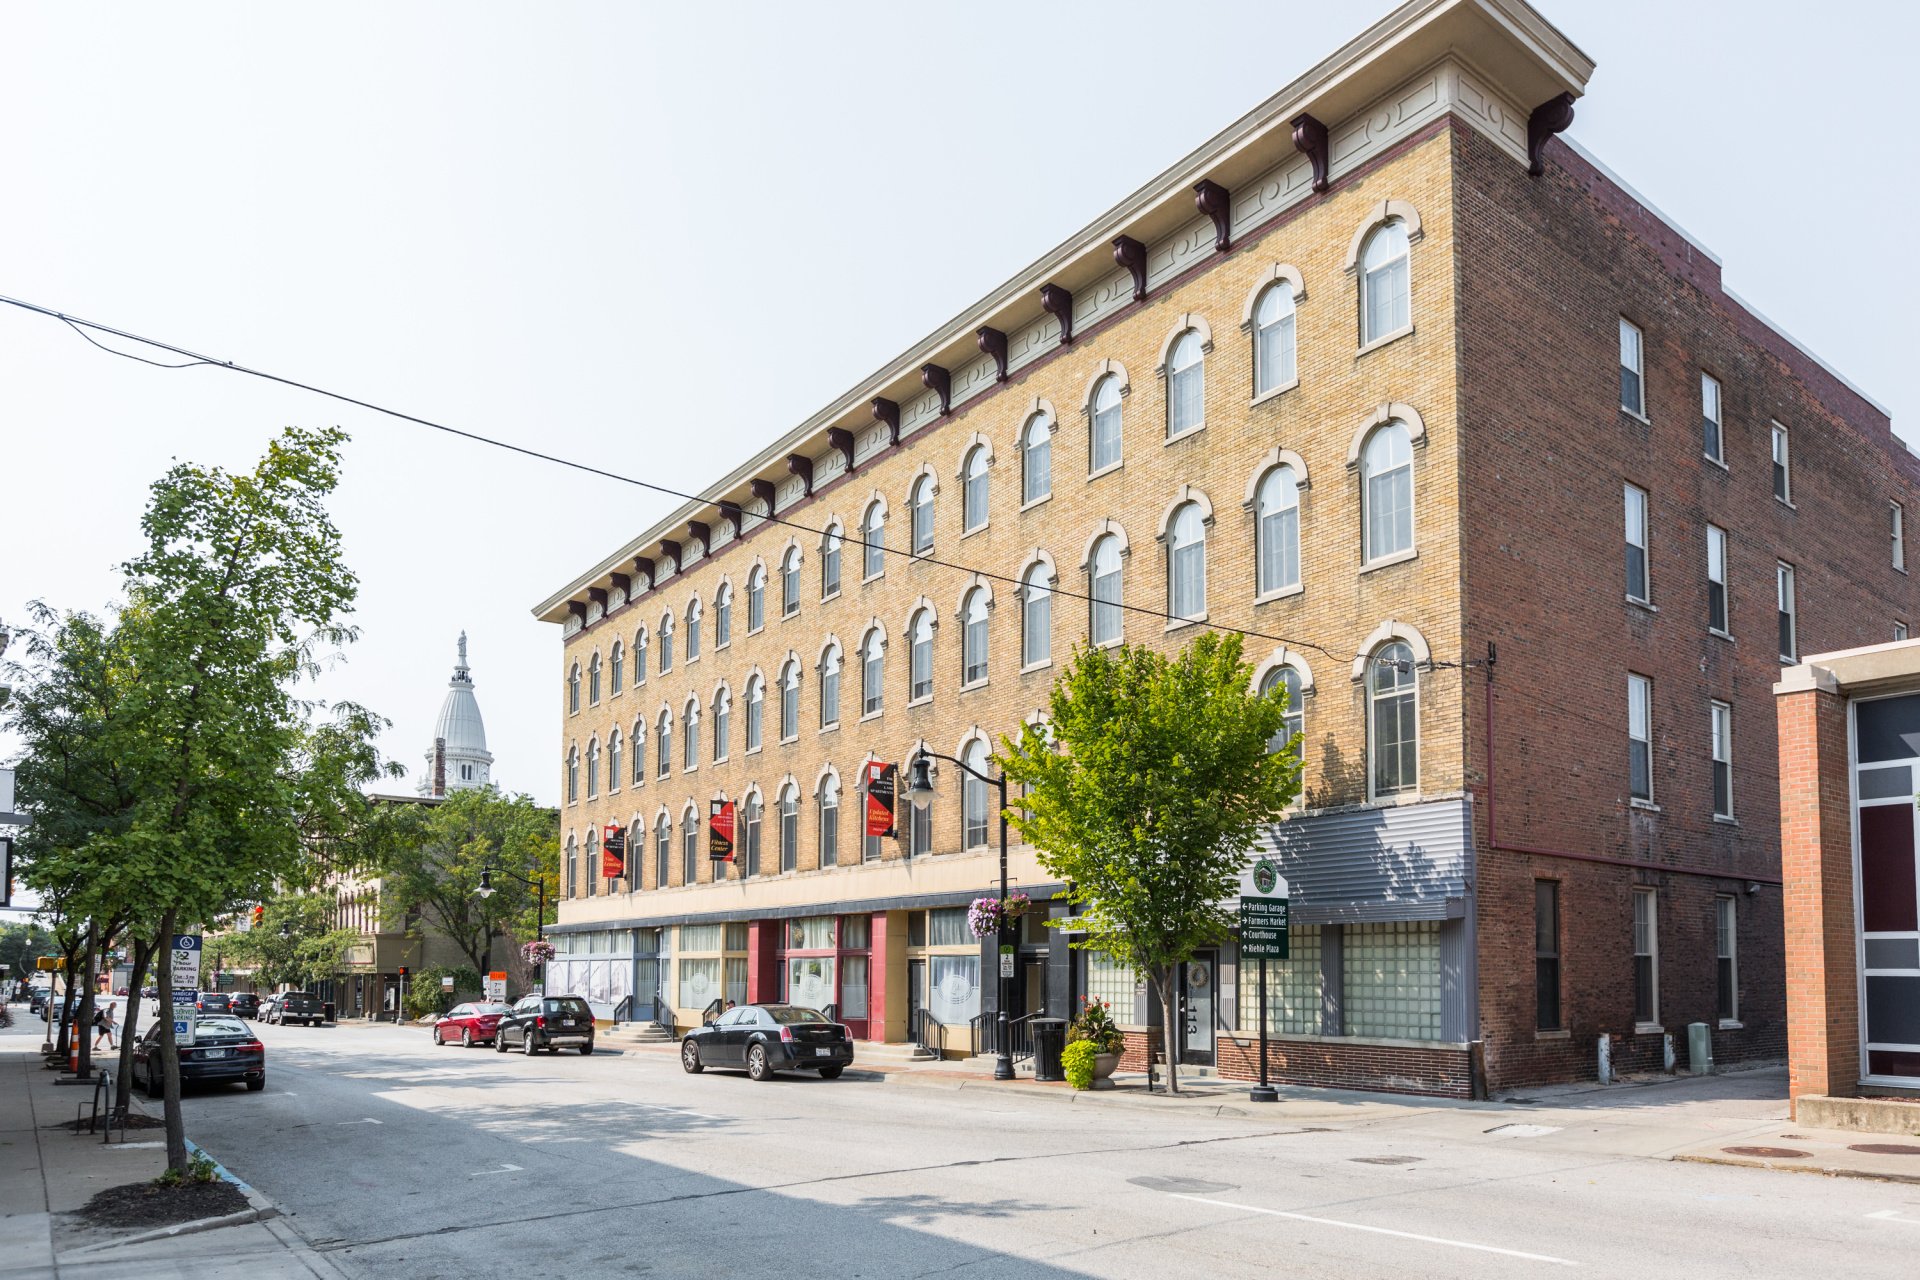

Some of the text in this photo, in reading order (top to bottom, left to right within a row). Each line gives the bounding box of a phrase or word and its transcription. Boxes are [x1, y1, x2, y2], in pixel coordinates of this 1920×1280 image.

[1248, 903, 1286, 914] Parking Garage
[1248, 917, 1286, 926] Farmers Market
[1248, 931, 1276, 939] Courthouse
[1248, 944, 1279, 953] Riehle Plaza
[182, 951, 189, 959] 2
[1188, 1006, 1197, 1034] 113
